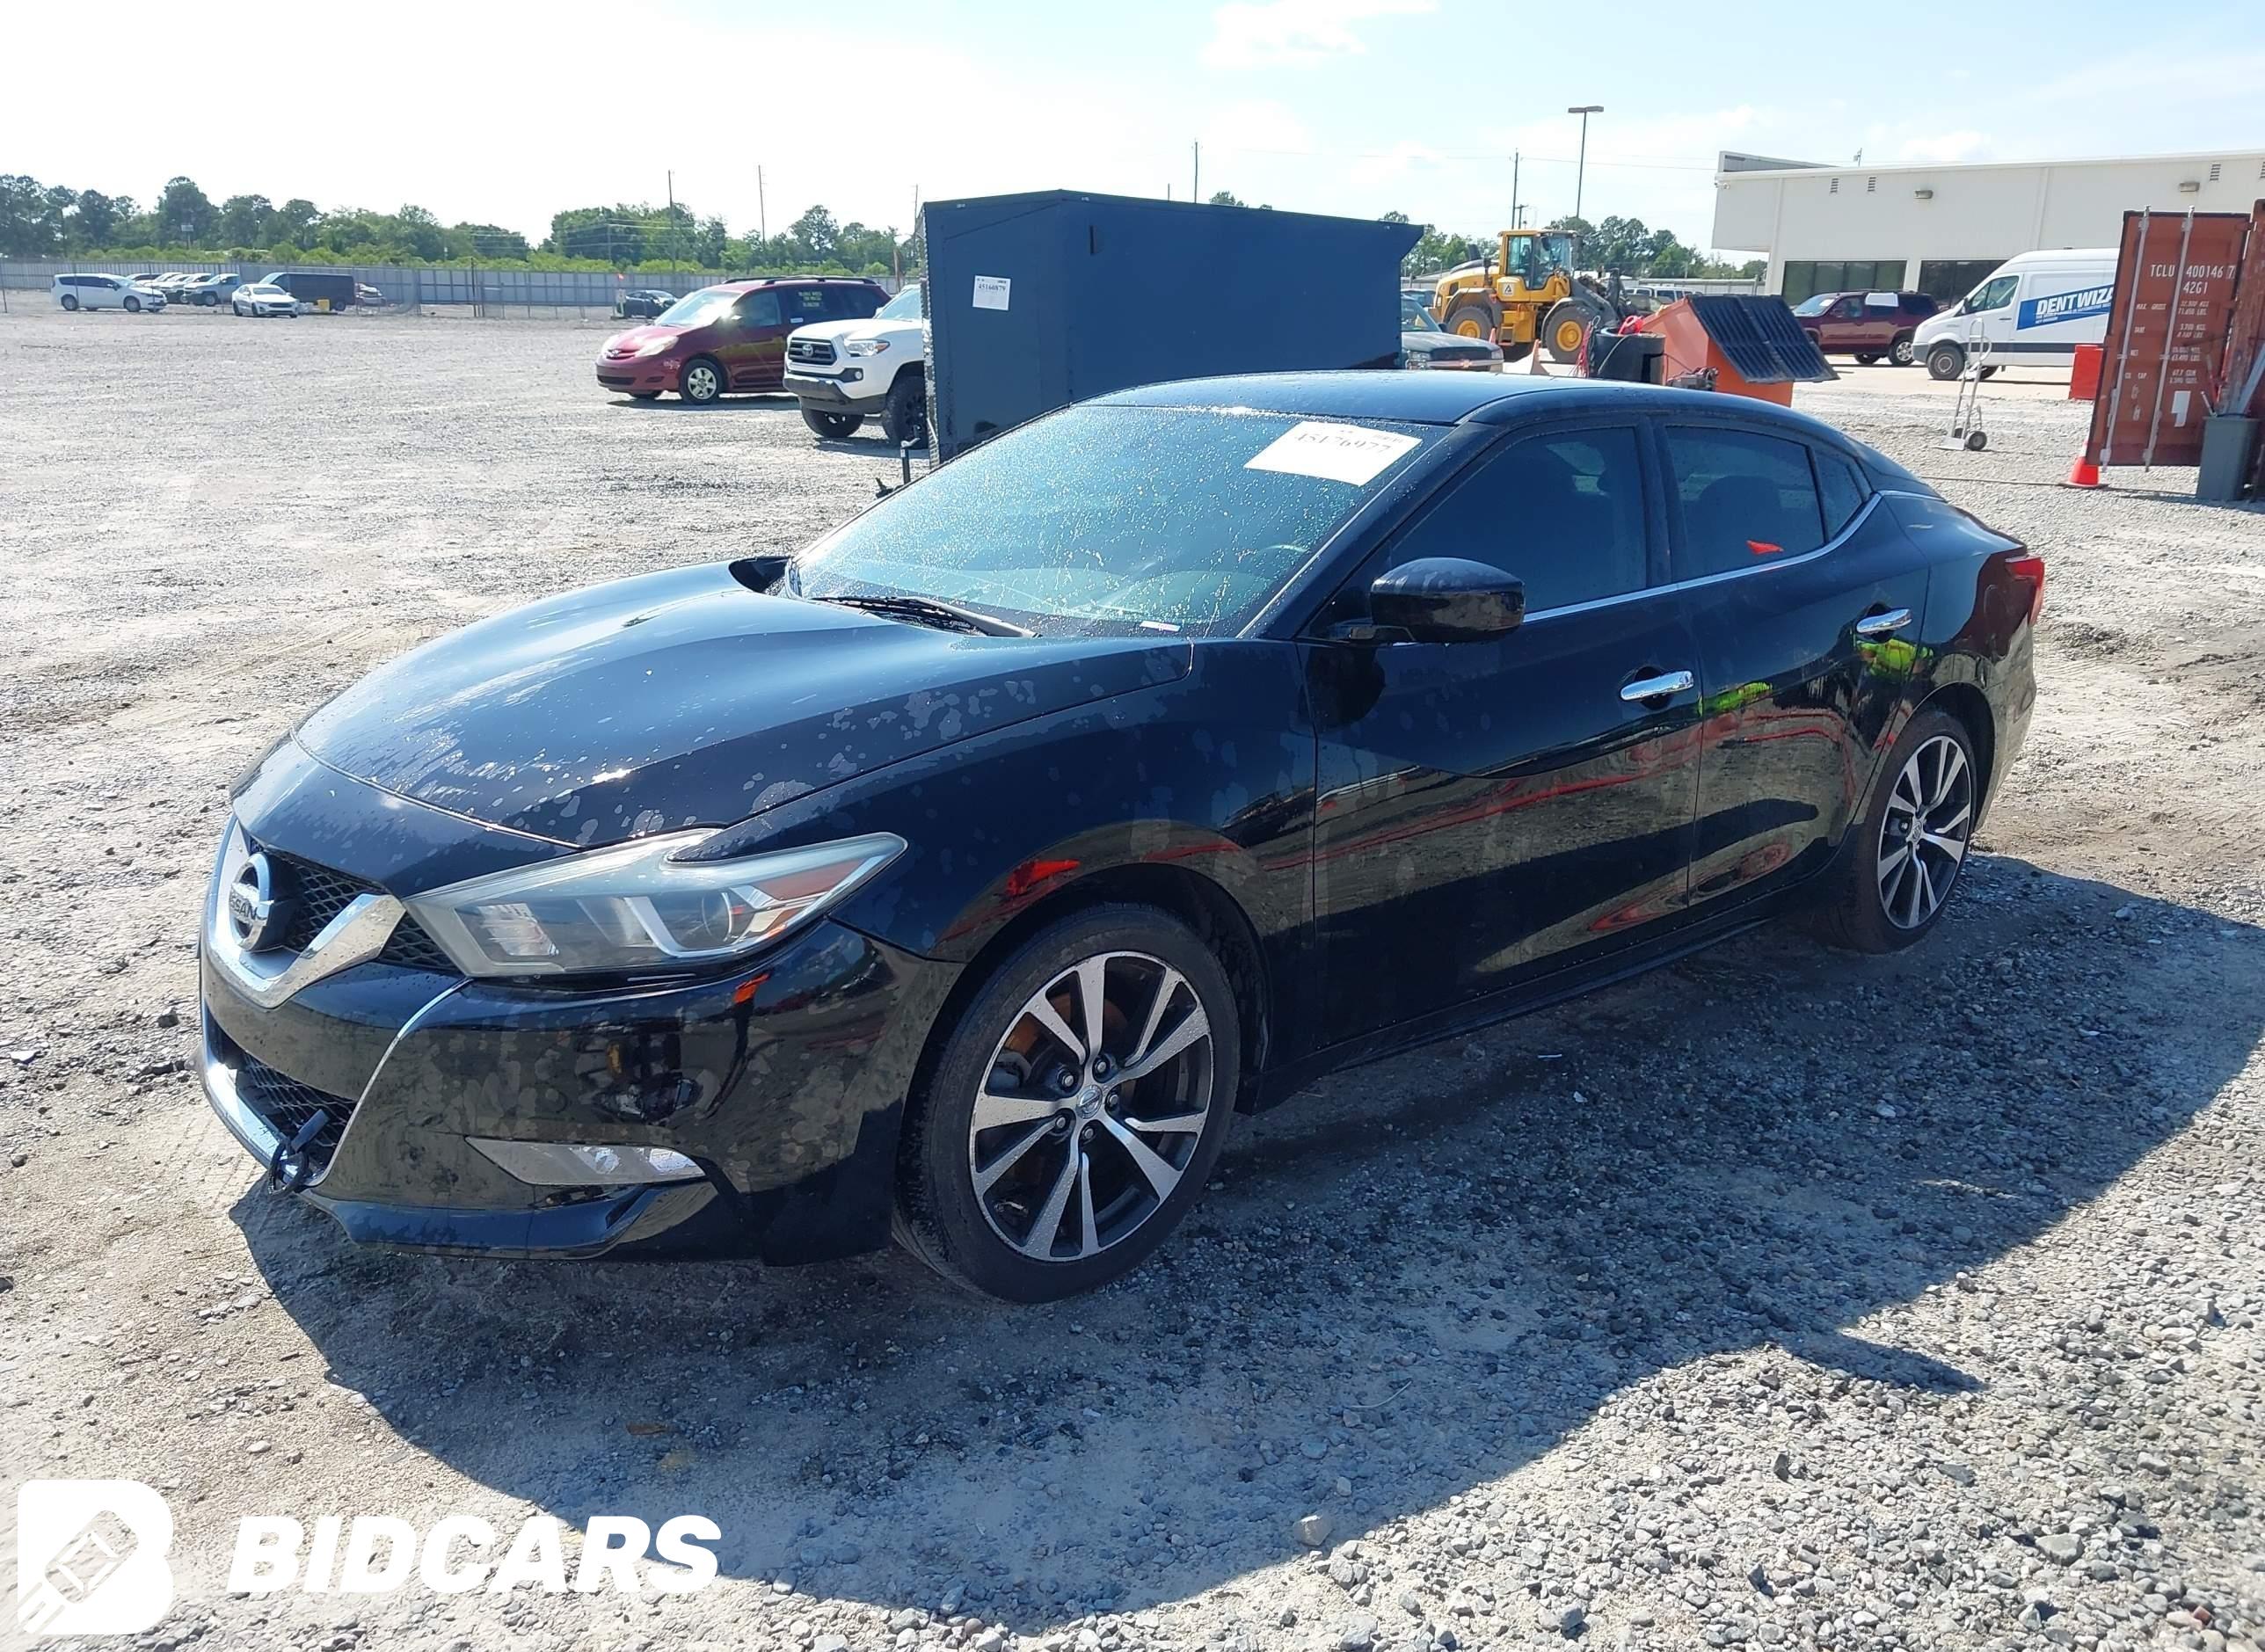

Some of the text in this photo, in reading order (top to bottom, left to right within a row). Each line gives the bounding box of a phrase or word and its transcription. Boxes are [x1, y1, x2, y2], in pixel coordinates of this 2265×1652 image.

[2150, 264, 2176, 277] TCLU
[2186, 265, 2224, 279] 400146
[2182, 281, 2208, 295] 42G1
